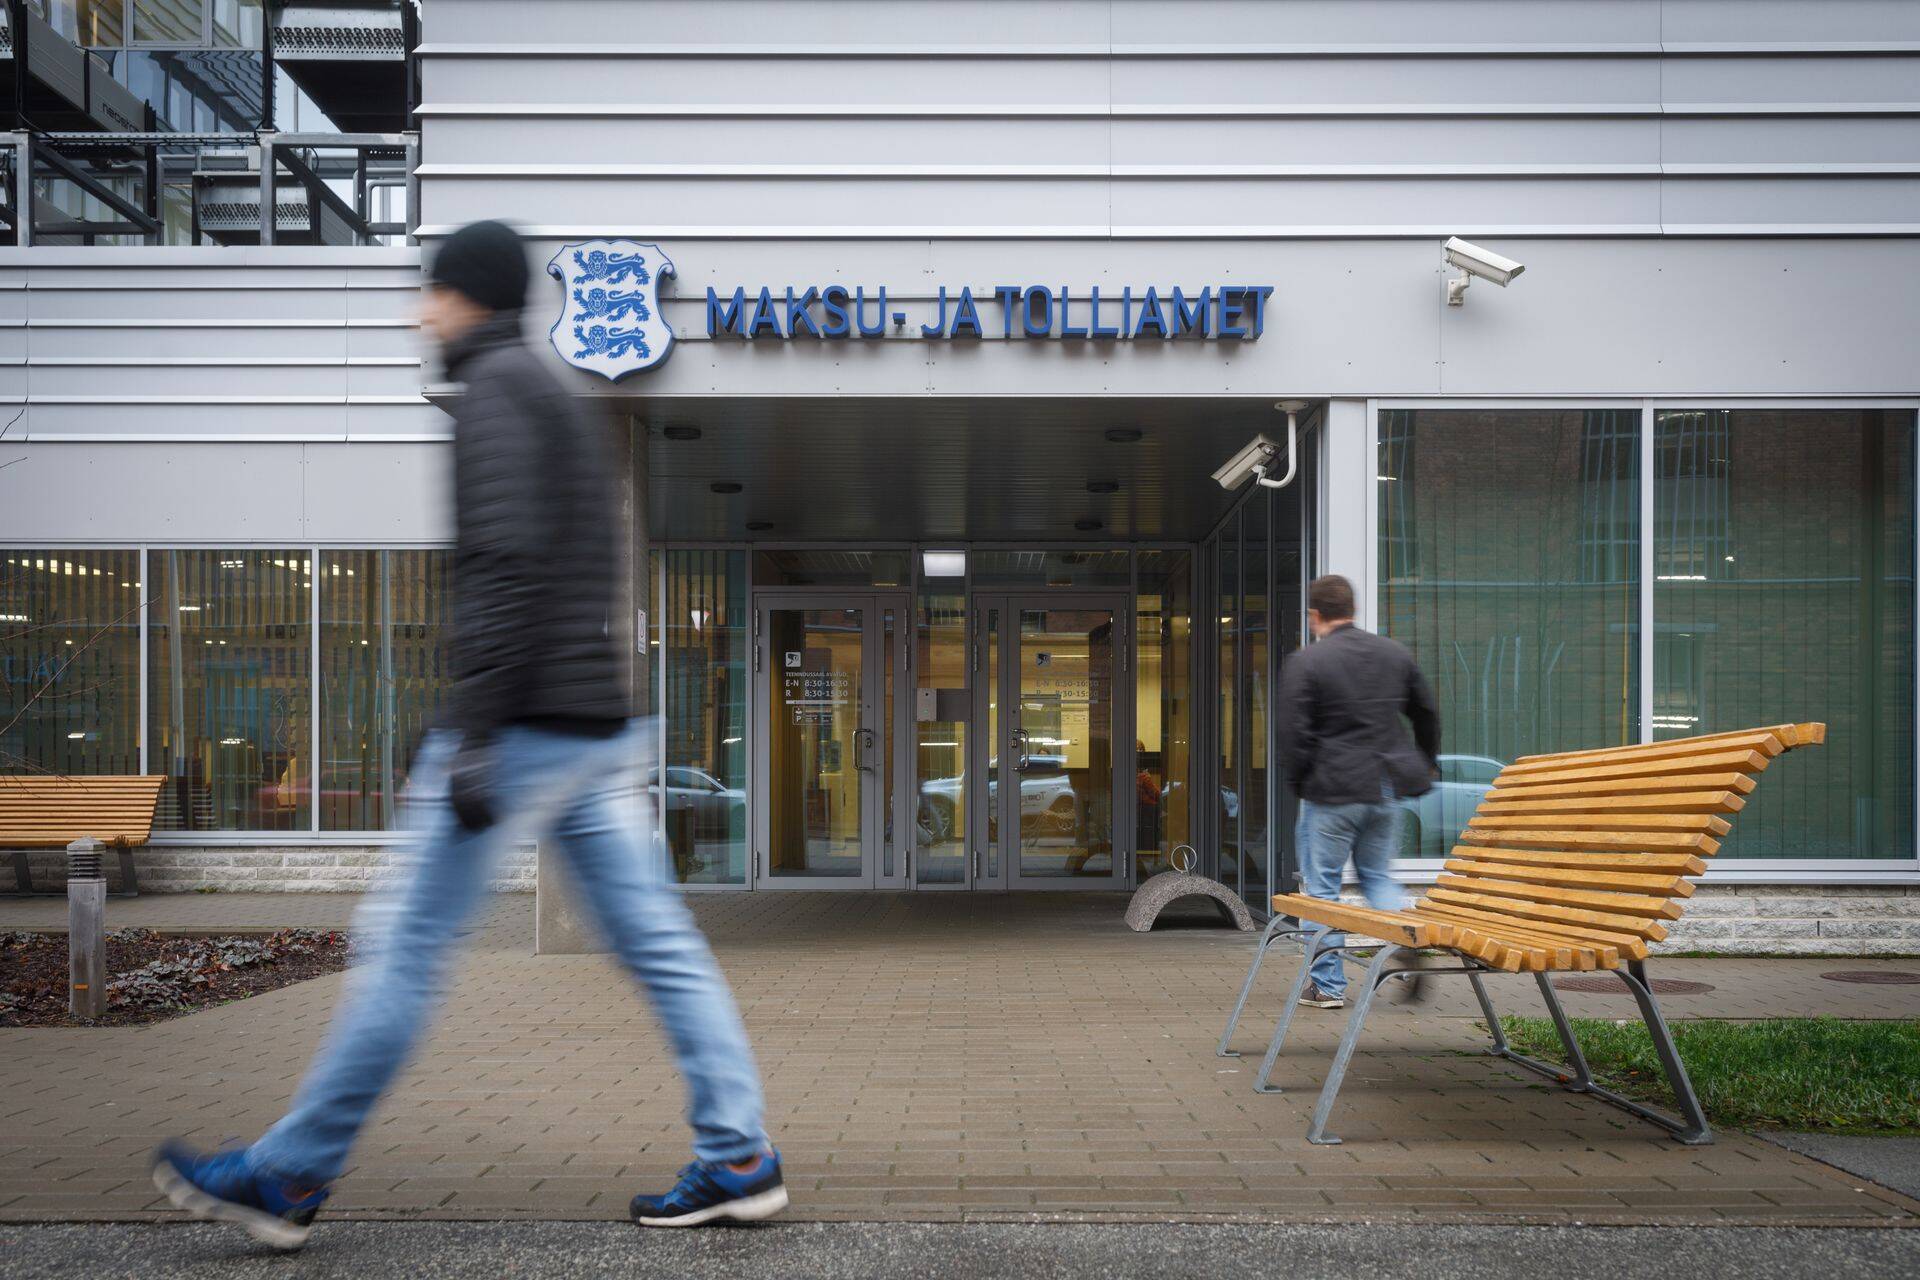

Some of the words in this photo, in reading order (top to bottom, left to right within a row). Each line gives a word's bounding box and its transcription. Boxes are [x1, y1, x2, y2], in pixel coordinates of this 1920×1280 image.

[706, 284, 907, 338] MAKSU-
[920, 284, 982, 338] JA
[994, 284, 1275, 339] TOLLIAMET
[785, 679, 800, 687] E-N
